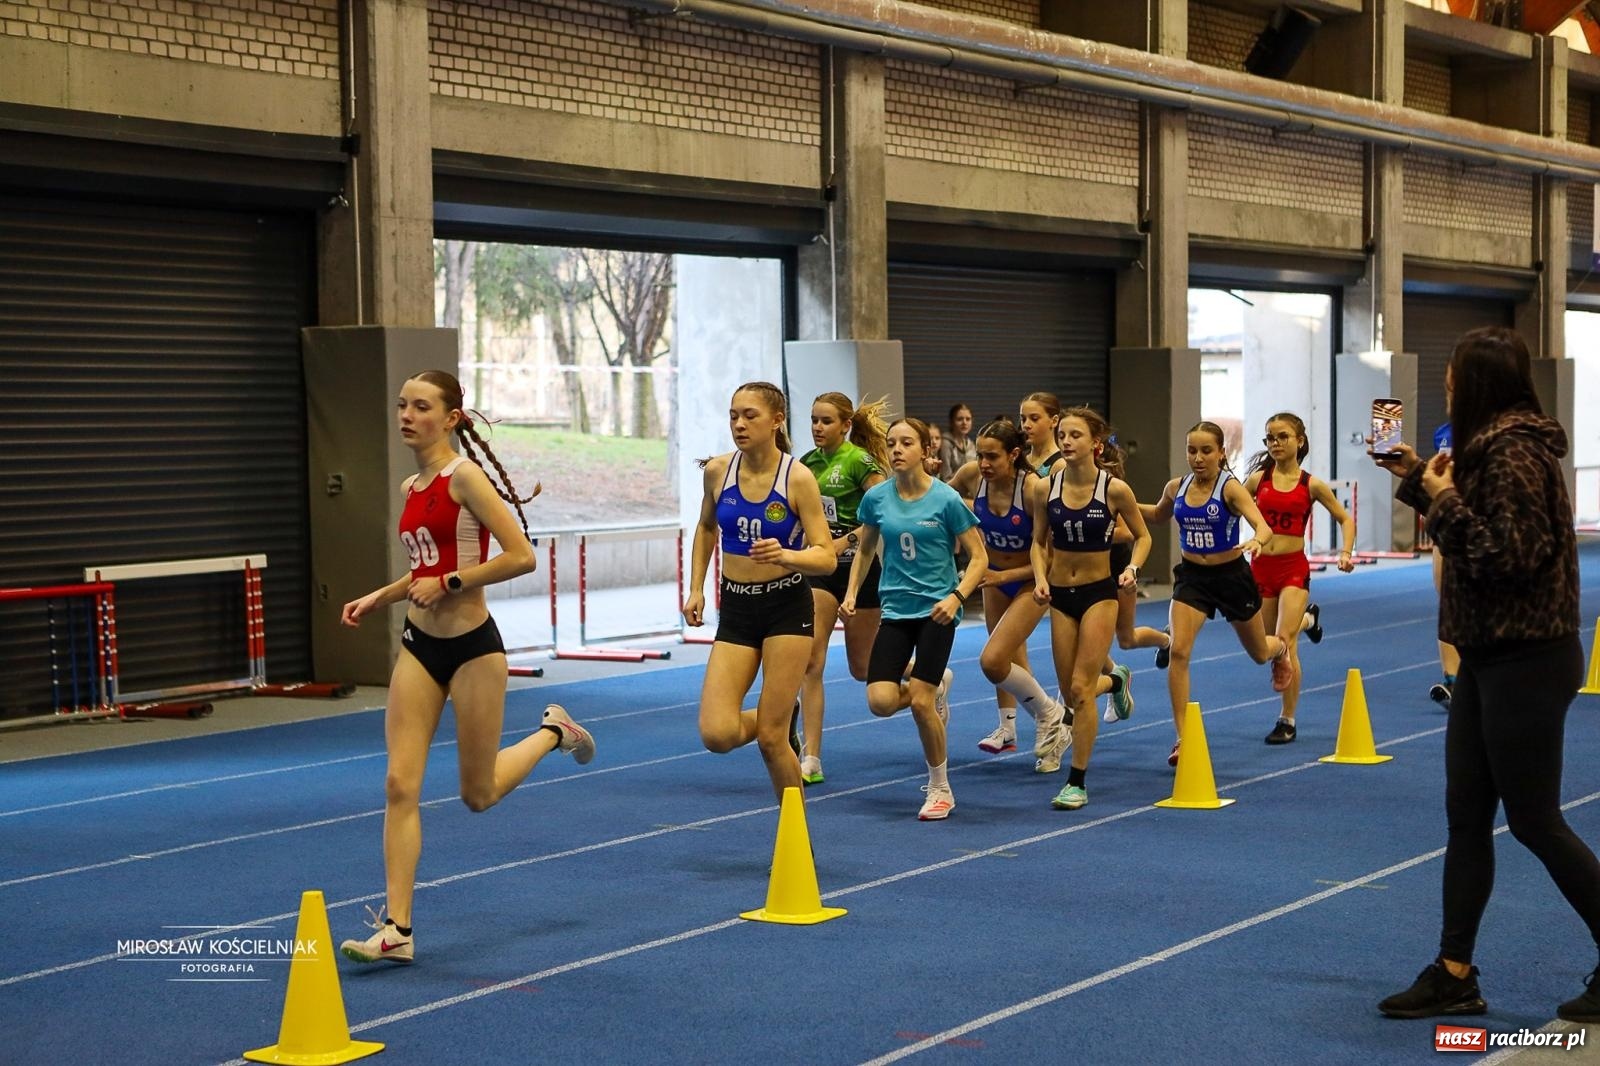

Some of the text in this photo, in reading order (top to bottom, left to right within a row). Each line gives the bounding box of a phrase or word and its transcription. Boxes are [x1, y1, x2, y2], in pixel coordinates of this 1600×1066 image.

[737, 516, 762, 543] 30
[1063, 520, 1085, 542] 11
[1267, 509, 1292, 530] 36
[401, 526, 440, 570] 90
[900, 532, 916, 561] 9
[726, 572, 803, 595] NIKE PRO
